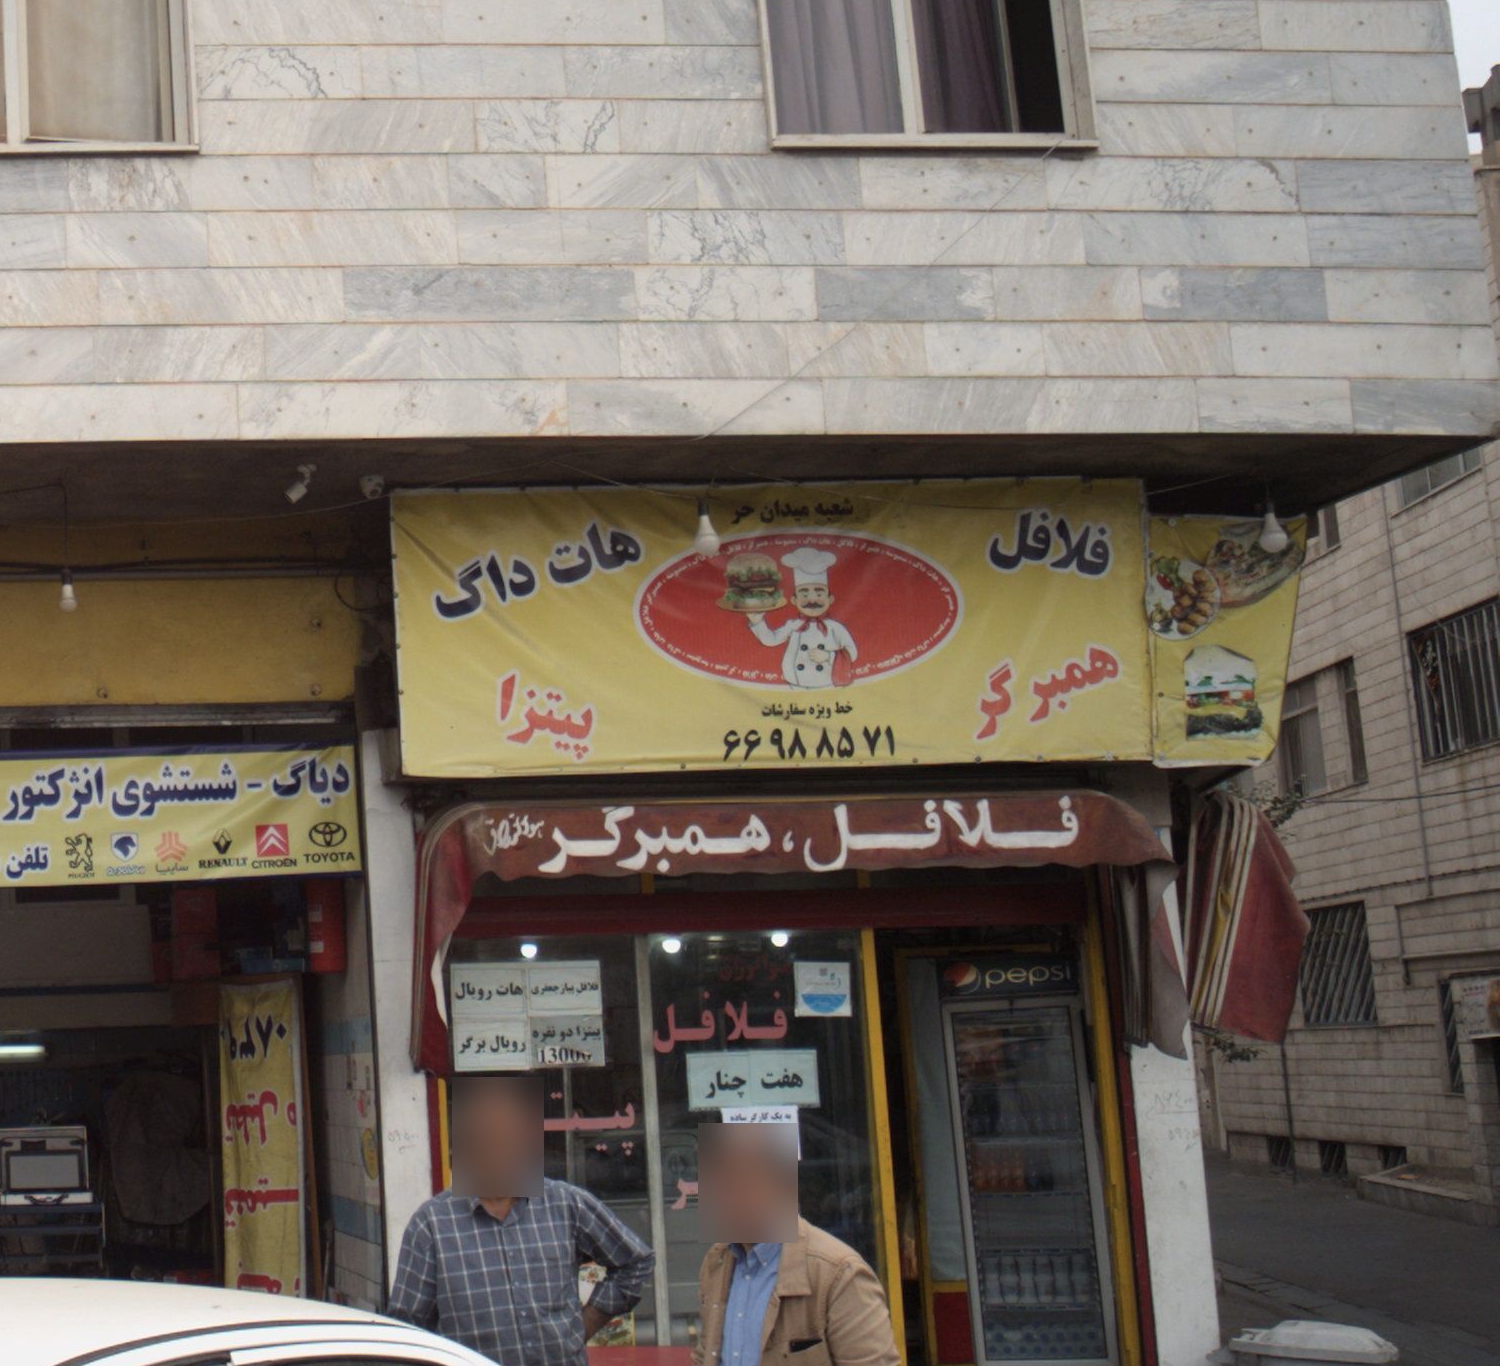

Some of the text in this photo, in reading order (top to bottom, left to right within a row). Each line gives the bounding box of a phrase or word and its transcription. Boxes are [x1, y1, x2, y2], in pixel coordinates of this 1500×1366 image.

[731, 498, 854, 524] شعبه میدان حر
[989, 510, 1111, 576] فلافل
[435, 522, 642, 619] هات داگ
[500, 673, 594, 761] پیتزا
[761, 701, 853, 720] خط ویژه سفارشات
[1, 765, 104, 821] انژکتور
[111, 763, 238, 818] شستشوی
[271, 757, 351, 805] دیاگ
[198, 856, 249, 870] RENAULT
[303, 851, 356, 865] TOYOTA
[495, 980, 524, 997] هات
[983, 960, 1072, 991] pepsi
[653, 989, 790, 1055] فلافل
[704, 1066, 804, 1100] هفت چنار
